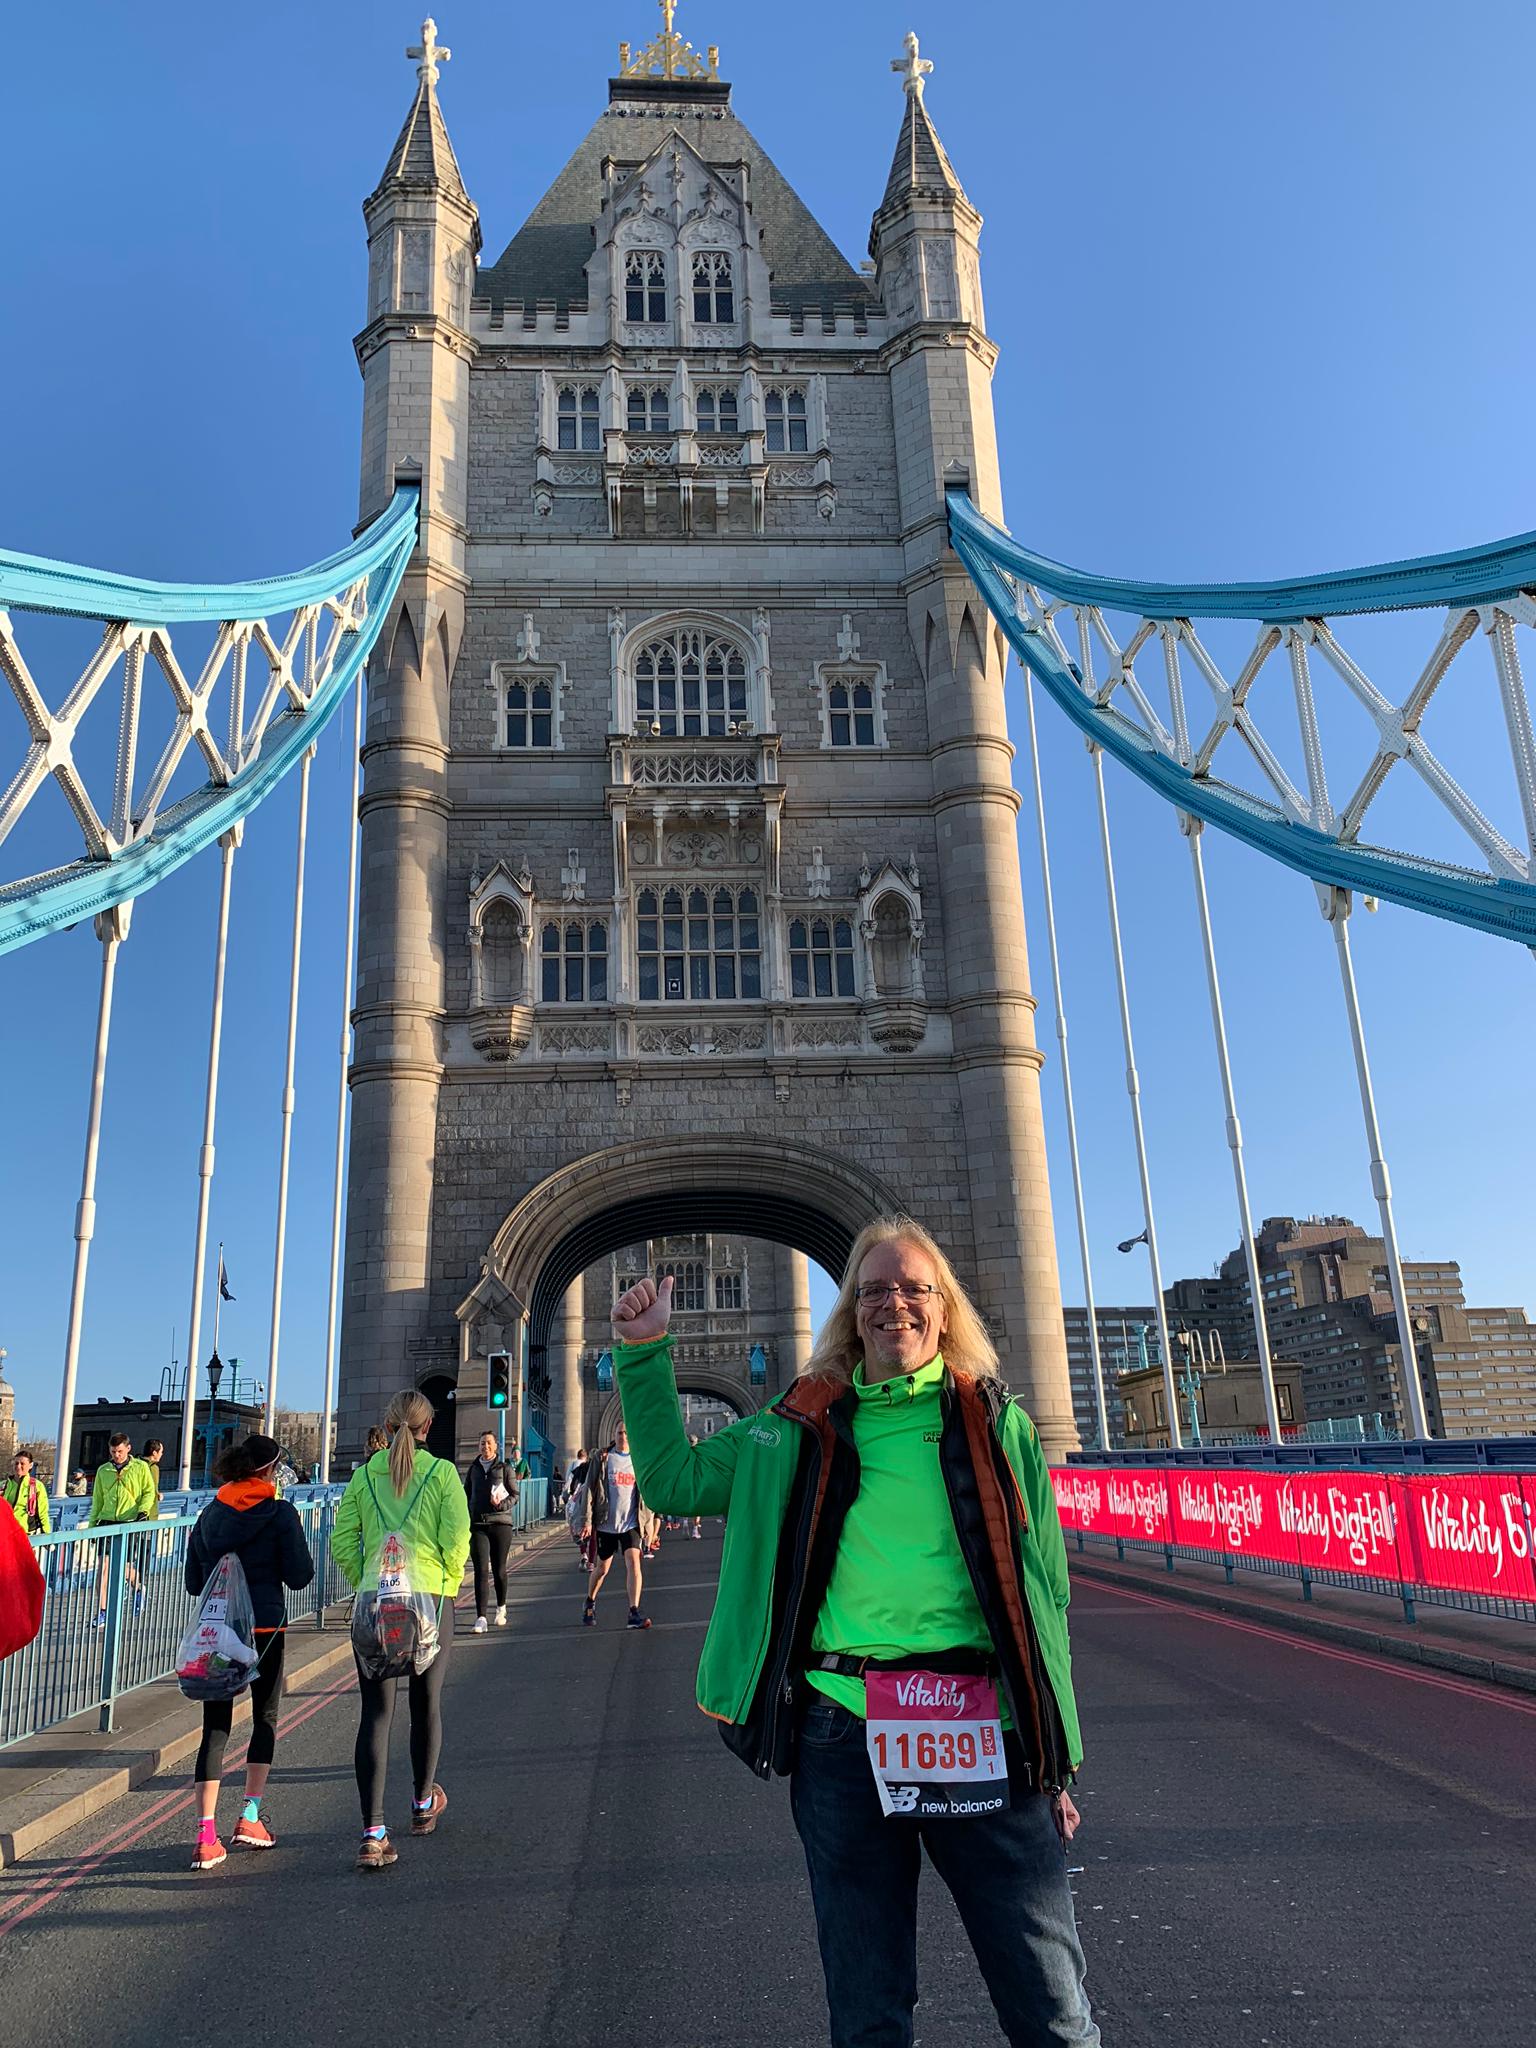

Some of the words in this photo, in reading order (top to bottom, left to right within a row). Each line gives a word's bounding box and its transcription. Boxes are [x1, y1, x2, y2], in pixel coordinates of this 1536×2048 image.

[1178, 1476, 1215, 1537] Vitality
[1276, 1479, 1329, 1554] Vitality
[1421, 1486, 1503, 1578] Vitality
[896, 1673, 966, 1717] Vitality
[873, 1732, 977, 1770] 11639
[921, 1803, 949, 1813] new
[950, 1799, 1003, 1813] balance
